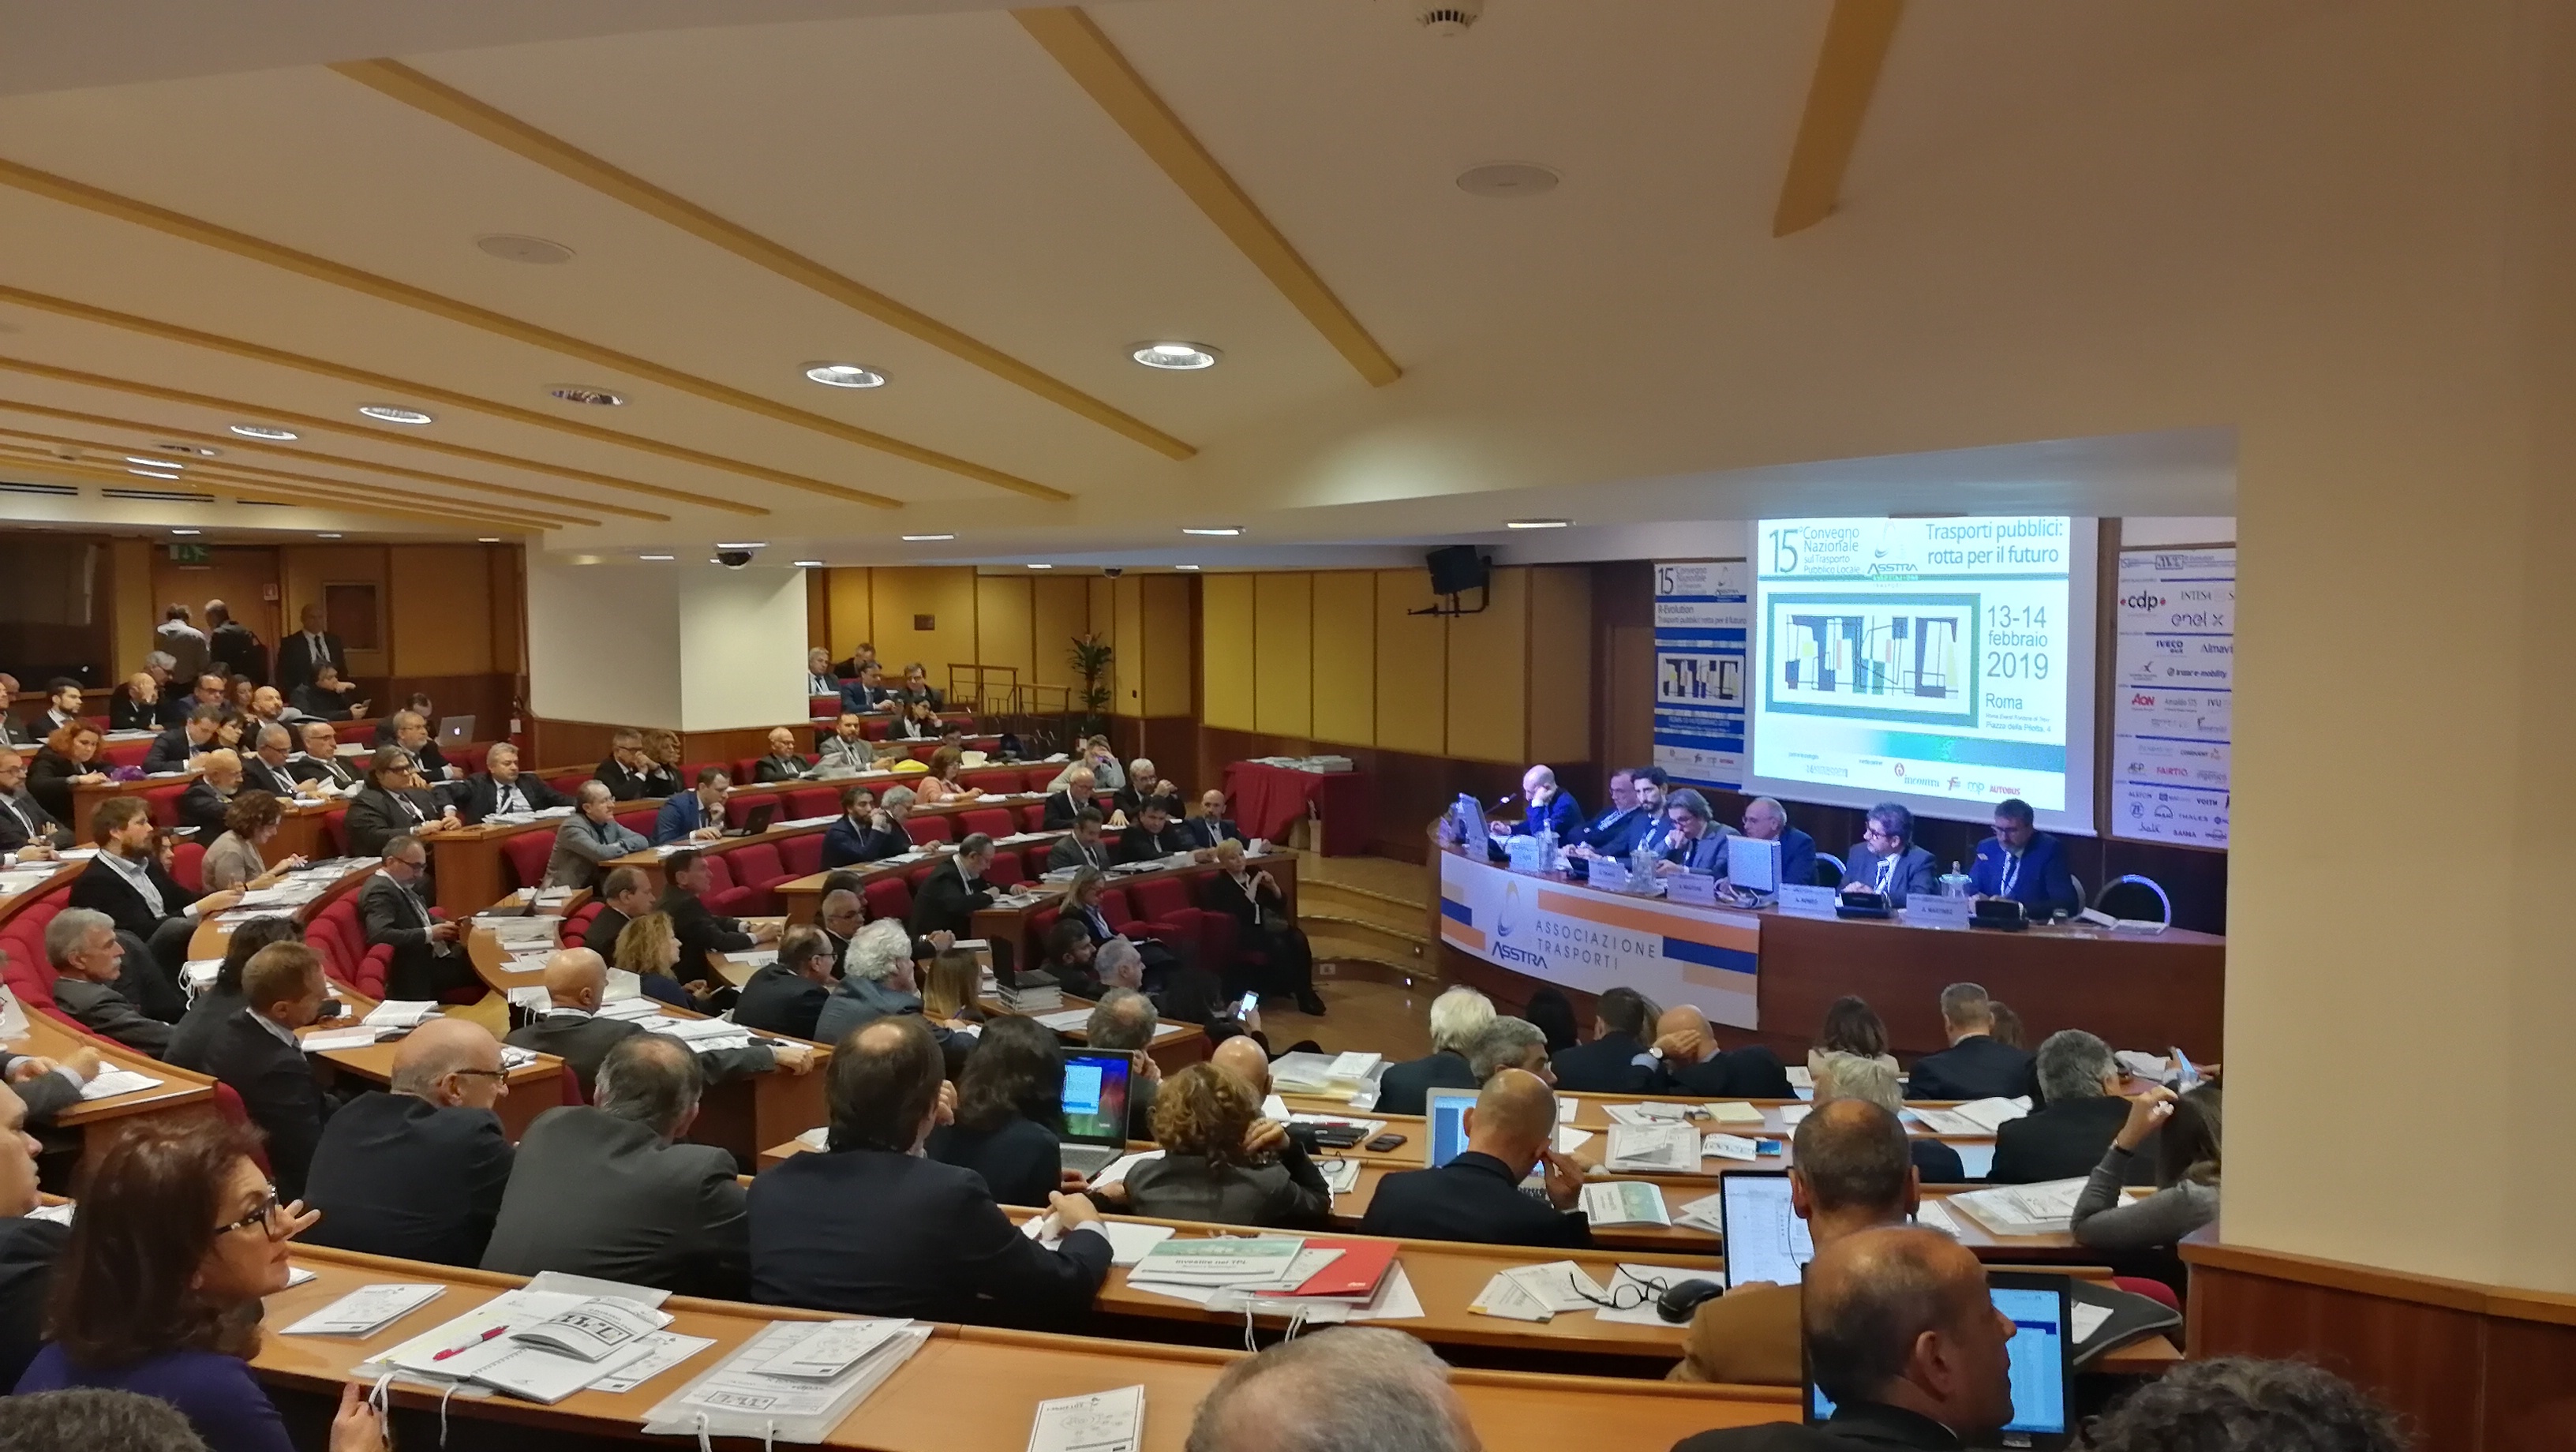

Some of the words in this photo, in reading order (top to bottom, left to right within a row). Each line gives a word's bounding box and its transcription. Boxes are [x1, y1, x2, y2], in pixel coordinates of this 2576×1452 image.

[1803, 526, 1859, 542] Convegno
[1926, 522, 1992, 544] Trasporti
[1997, 518, 2063, 544] pubblici:
[1804, 540, 1859, 552] Nazionale
[1804, 555, 1814, 563] sul
[1816, 554, 1850, 565] Trasporto
[1928, 549, 1963, 564] rotta
[1968, 550, 1994, 569] per
[1997, 546, 2004, 563] il
[2008, 545, 2059, 563] futuro
[1804, 565, 1835, 574] Pubblico
[1837, 566, 1860, 574] Locale
[1867, 563, 1918, 574] ASSTRA
[2129, 590, 2158, 612] cdp
[1987, 605, 2046, 628] 13-14
[2171, 611, 2207, 627] enel
[1988, 631, 2048, 647] febbraio
[1987, 651, 2048, 680] 2019
[1986, 693, 2023, 709] Roma
[2132, 694, 2155, 705] AON
[1986, 721, 2006, 730] Piazza
[1990, 784, 2020, 795] AUTOBUS
[1537, 921, 1655, 958] ASSOCIAZIONE
[1492, 941, 1548, 969] ASSTRA
[1538, 938, 1617, 970] TRASPORTI
